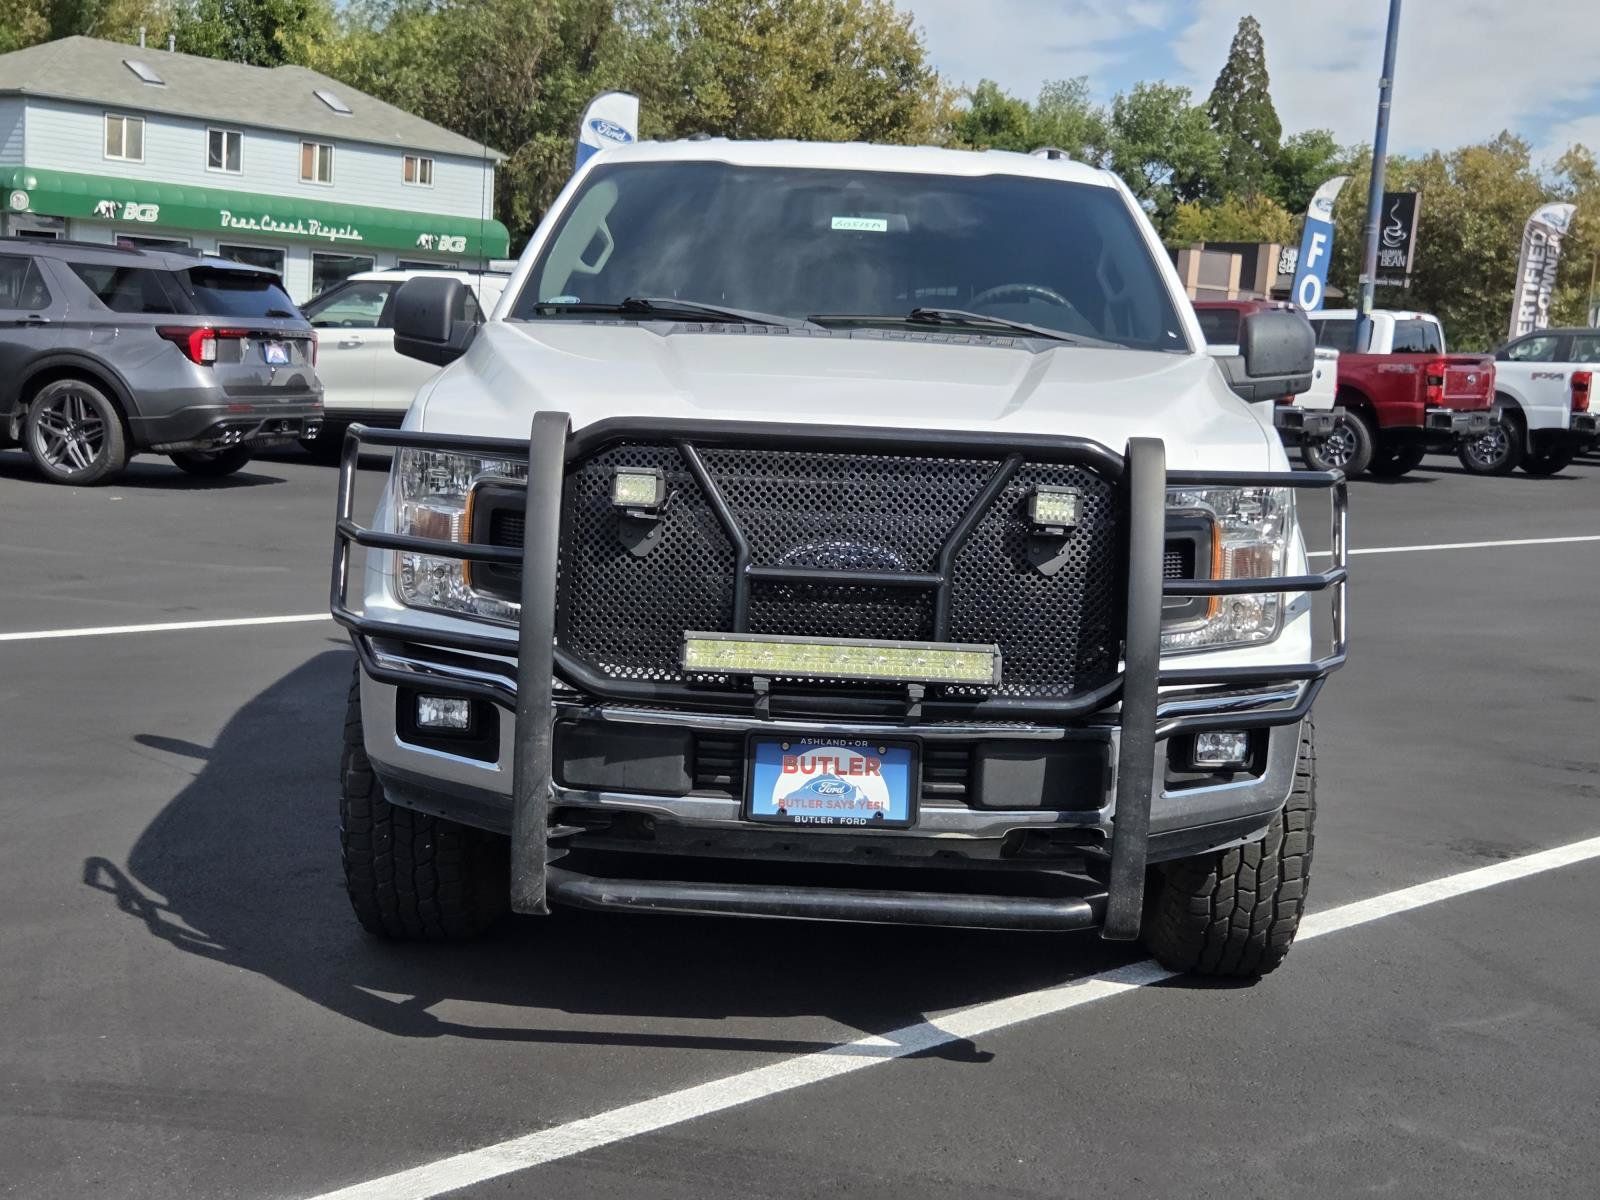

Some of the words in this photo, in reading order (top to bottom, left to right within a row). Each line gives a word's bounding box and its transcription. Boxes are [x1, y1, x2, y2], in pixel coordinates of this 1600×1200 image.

[597, 122, 626, 140] Ford
[219, 209, 261, 230] Bear
[261, 214, 308, 234] Creek
[307, 219, 363, 242] Bicycle
[1380, 255, 1406, 267] BEAN
[1298, 232, 1327, 311] FO
[1516, 229, 1548, 337] ERTIFIED
[800, 737, 847, 747] ASHLAND
[854, 739, 869, 748] OR
[782, 754, 882, 777] BUTLER
[818, 780, 845, 795] Ford
[778, 798, 823, 809] BUTLER
[825, 799, 855, 810] SAYS
[858, 800, 885, 811] YES!
[794, 815, 834, 825] BUTLER
[840, 816, 867, 826] FORD
